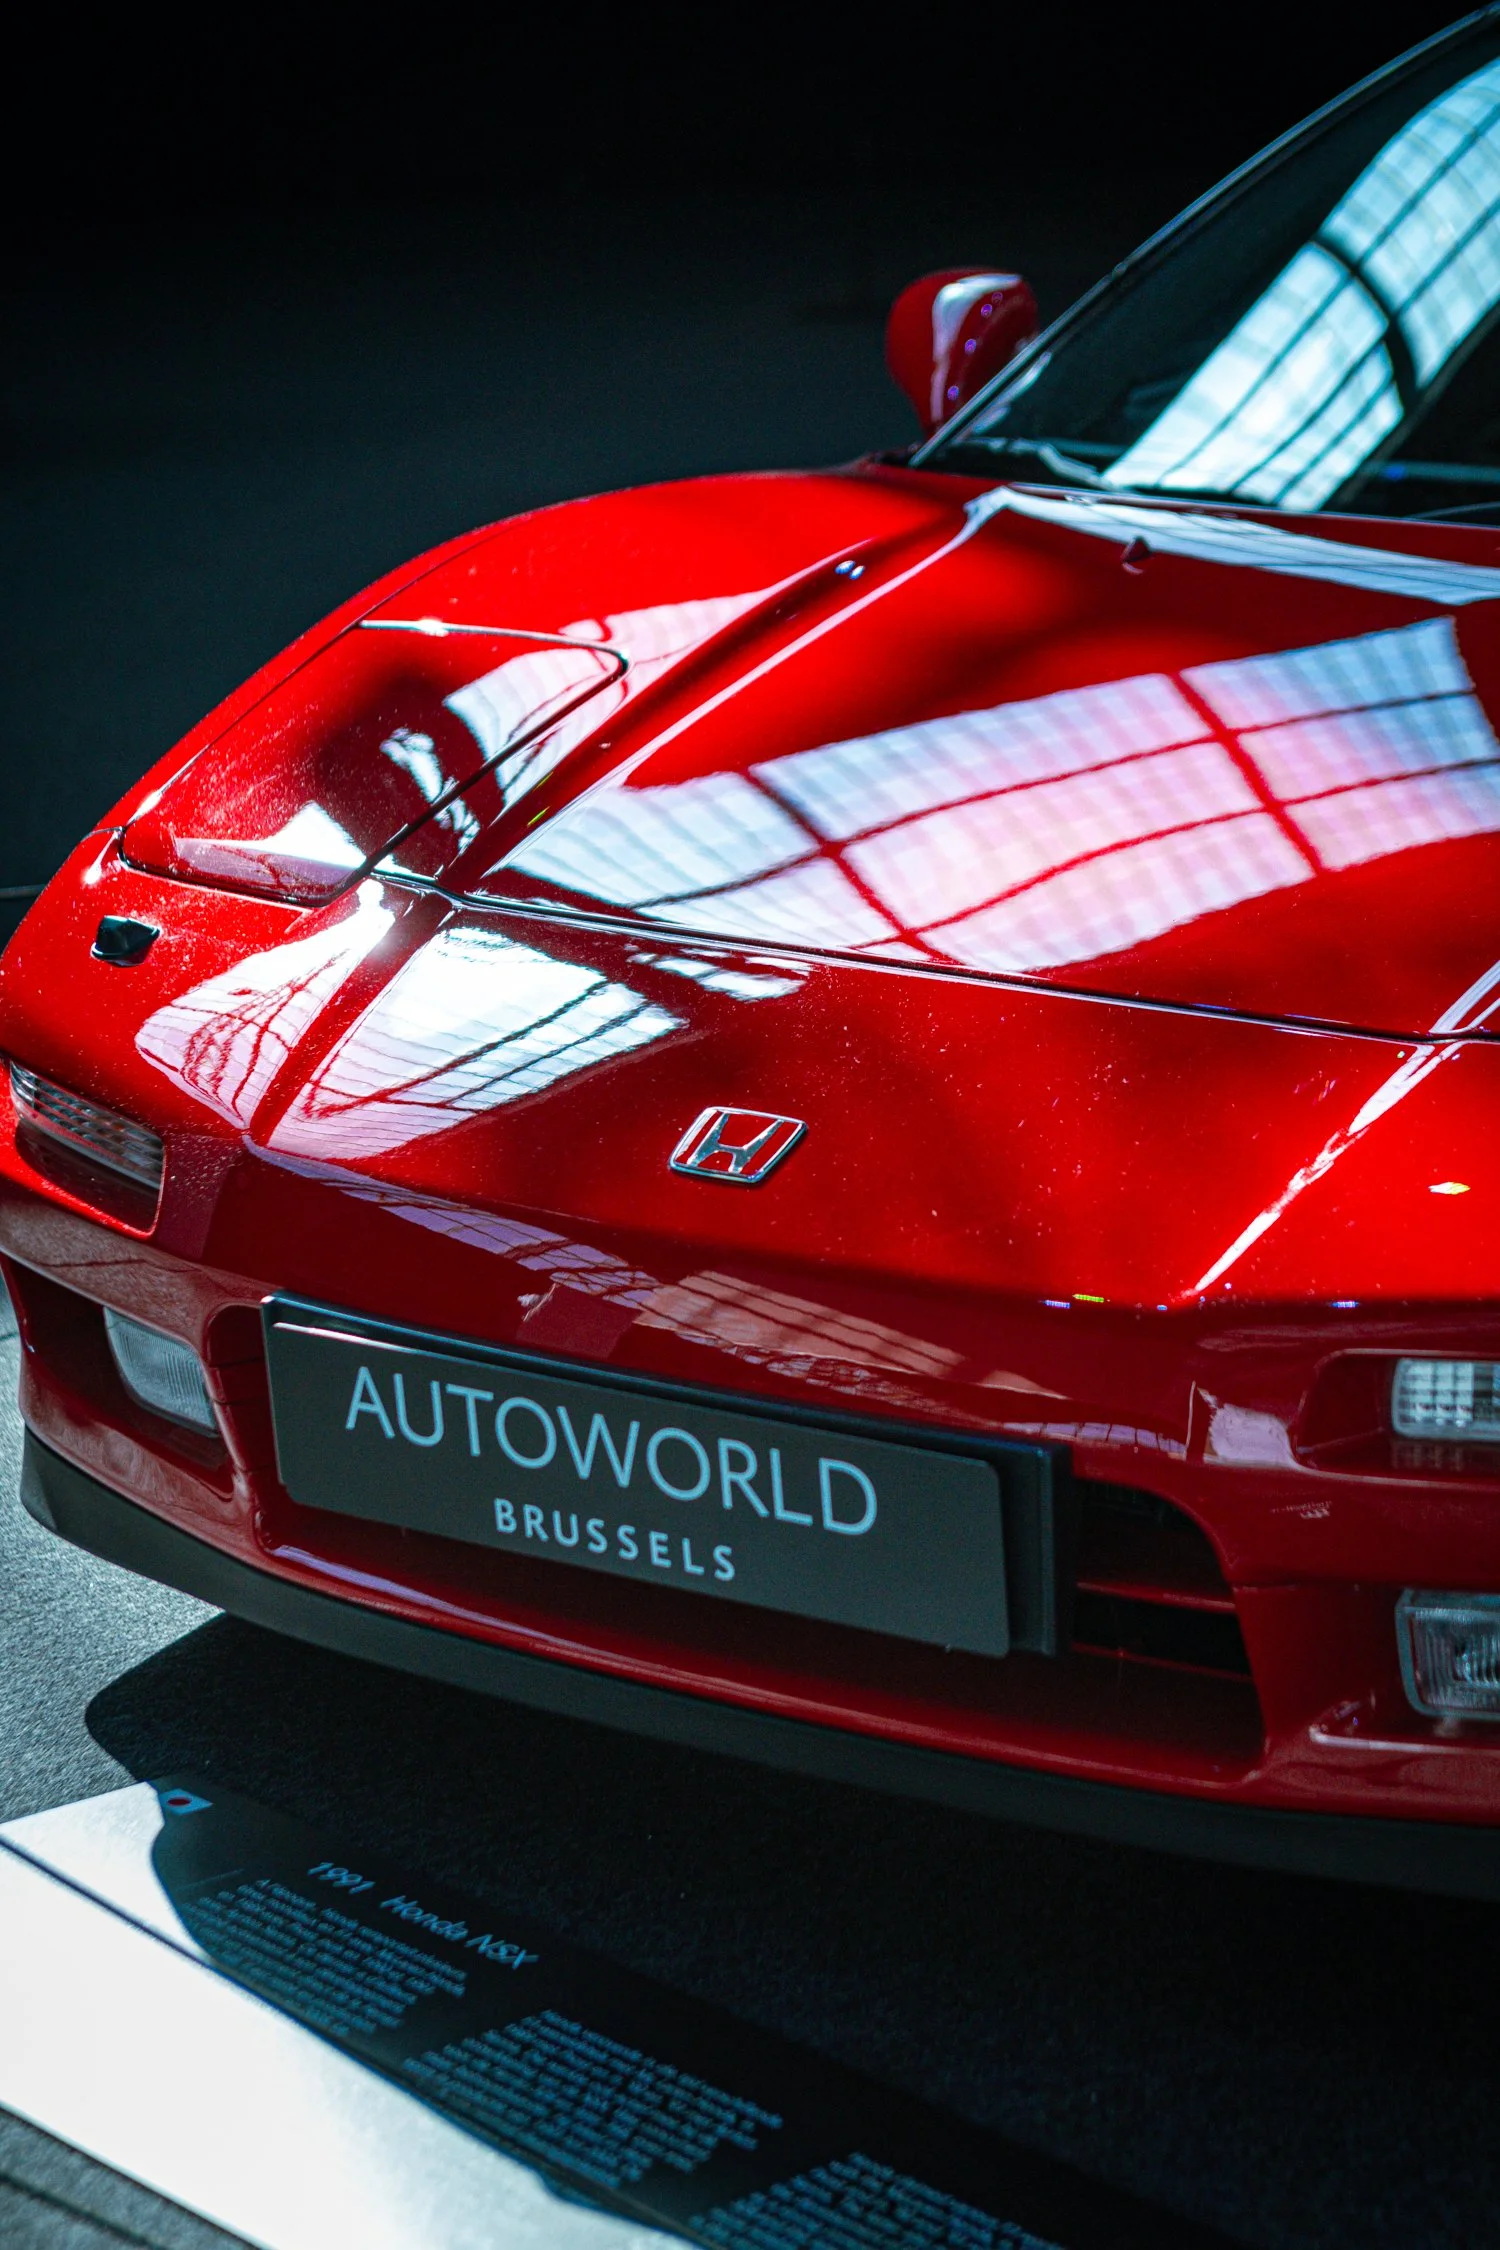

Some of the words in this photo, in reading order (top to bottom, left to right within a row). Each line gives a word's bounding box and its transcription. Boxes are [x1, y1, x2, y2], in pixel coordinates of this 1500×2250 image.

[345, 1366, 877, 1535] AUTOWORLD
[494, 1497, 735, 1581] BRUSSELS
[307, 1861, 376, 1895] 1991
[379, 1895, 469, 1941] Honda
[464, 1933, 540, 1970] NSX
